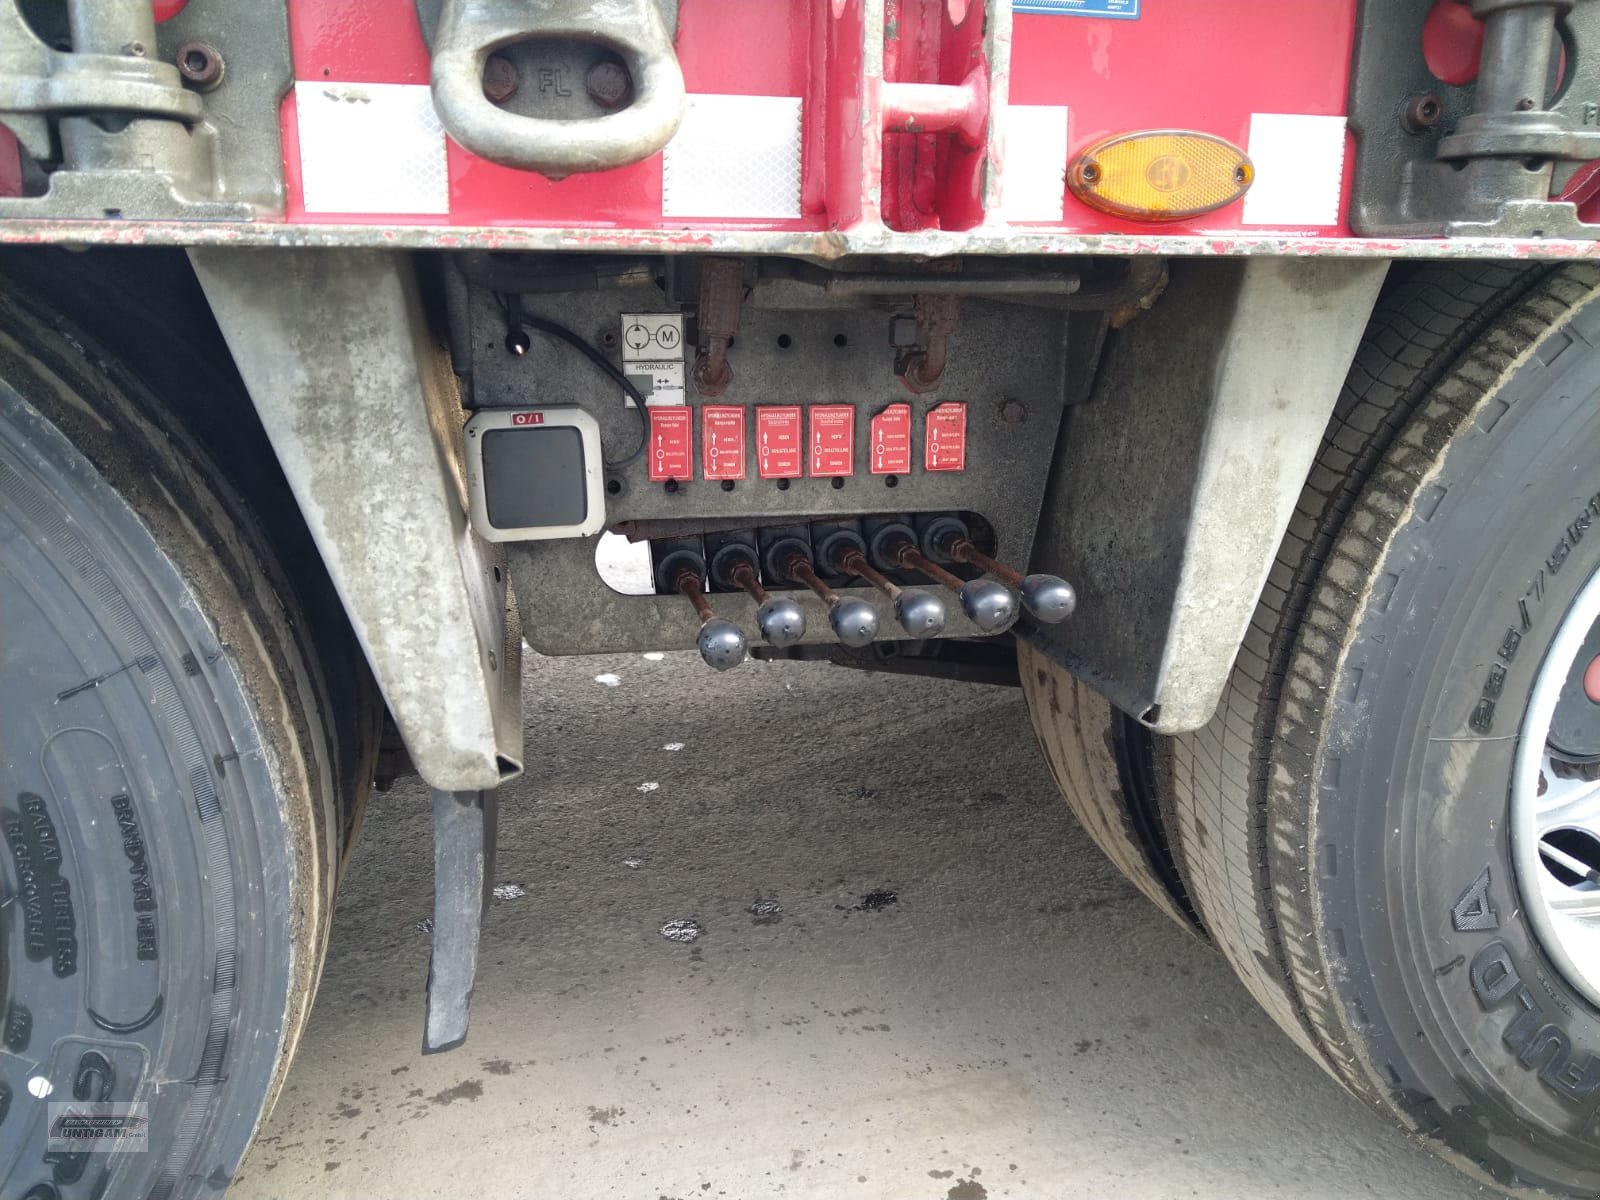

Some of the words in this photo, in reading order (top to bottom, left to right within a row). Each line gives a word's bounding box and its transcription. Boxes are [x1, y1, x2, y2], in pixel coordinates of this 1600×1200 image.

[539, 68, 572, 98] FL
[661, 330, 674, 343] M
[635, 363, 675, 371] HYDRAULIC
[112, 793, 145, 863] BRAND
[24, 797, 59, 861] RADIAL
[49, 877, 74, 974] TUBELESS
[129, 863, 157, 910] TYRE
[135, 911, 158, 959] HERE
[1450, 864, 1600, 1099] FULDA
